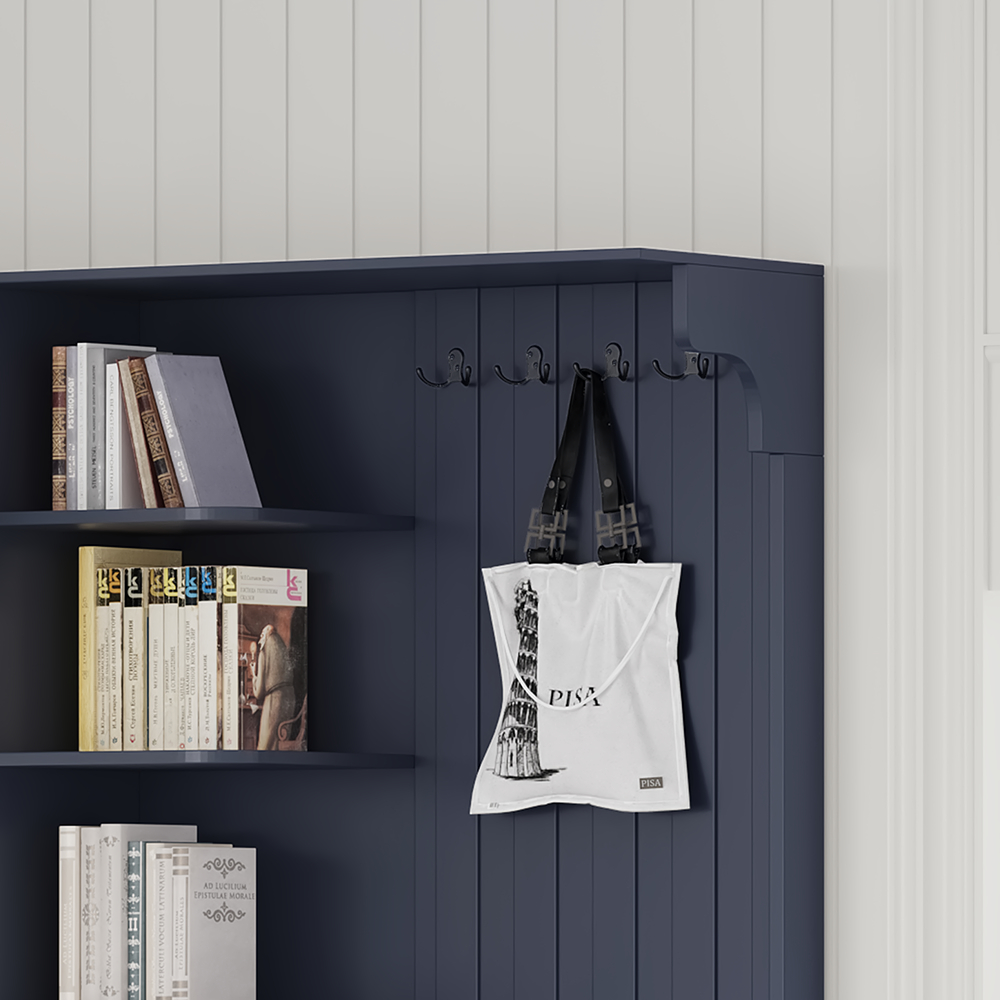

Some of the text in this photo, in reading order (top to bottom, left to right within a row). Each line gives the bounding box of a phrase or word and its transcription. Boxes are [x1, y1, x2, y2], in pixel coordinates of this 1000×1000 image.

[67, 376, 75, 430] PSYCHOLOGY
[156, 390, 174, 438] PSYCHOLOGY
[548, 686, 601, 708] PISA
[640, 778, 662, 788] PISA
[194, 891, 227, 899] EPISTULAE
